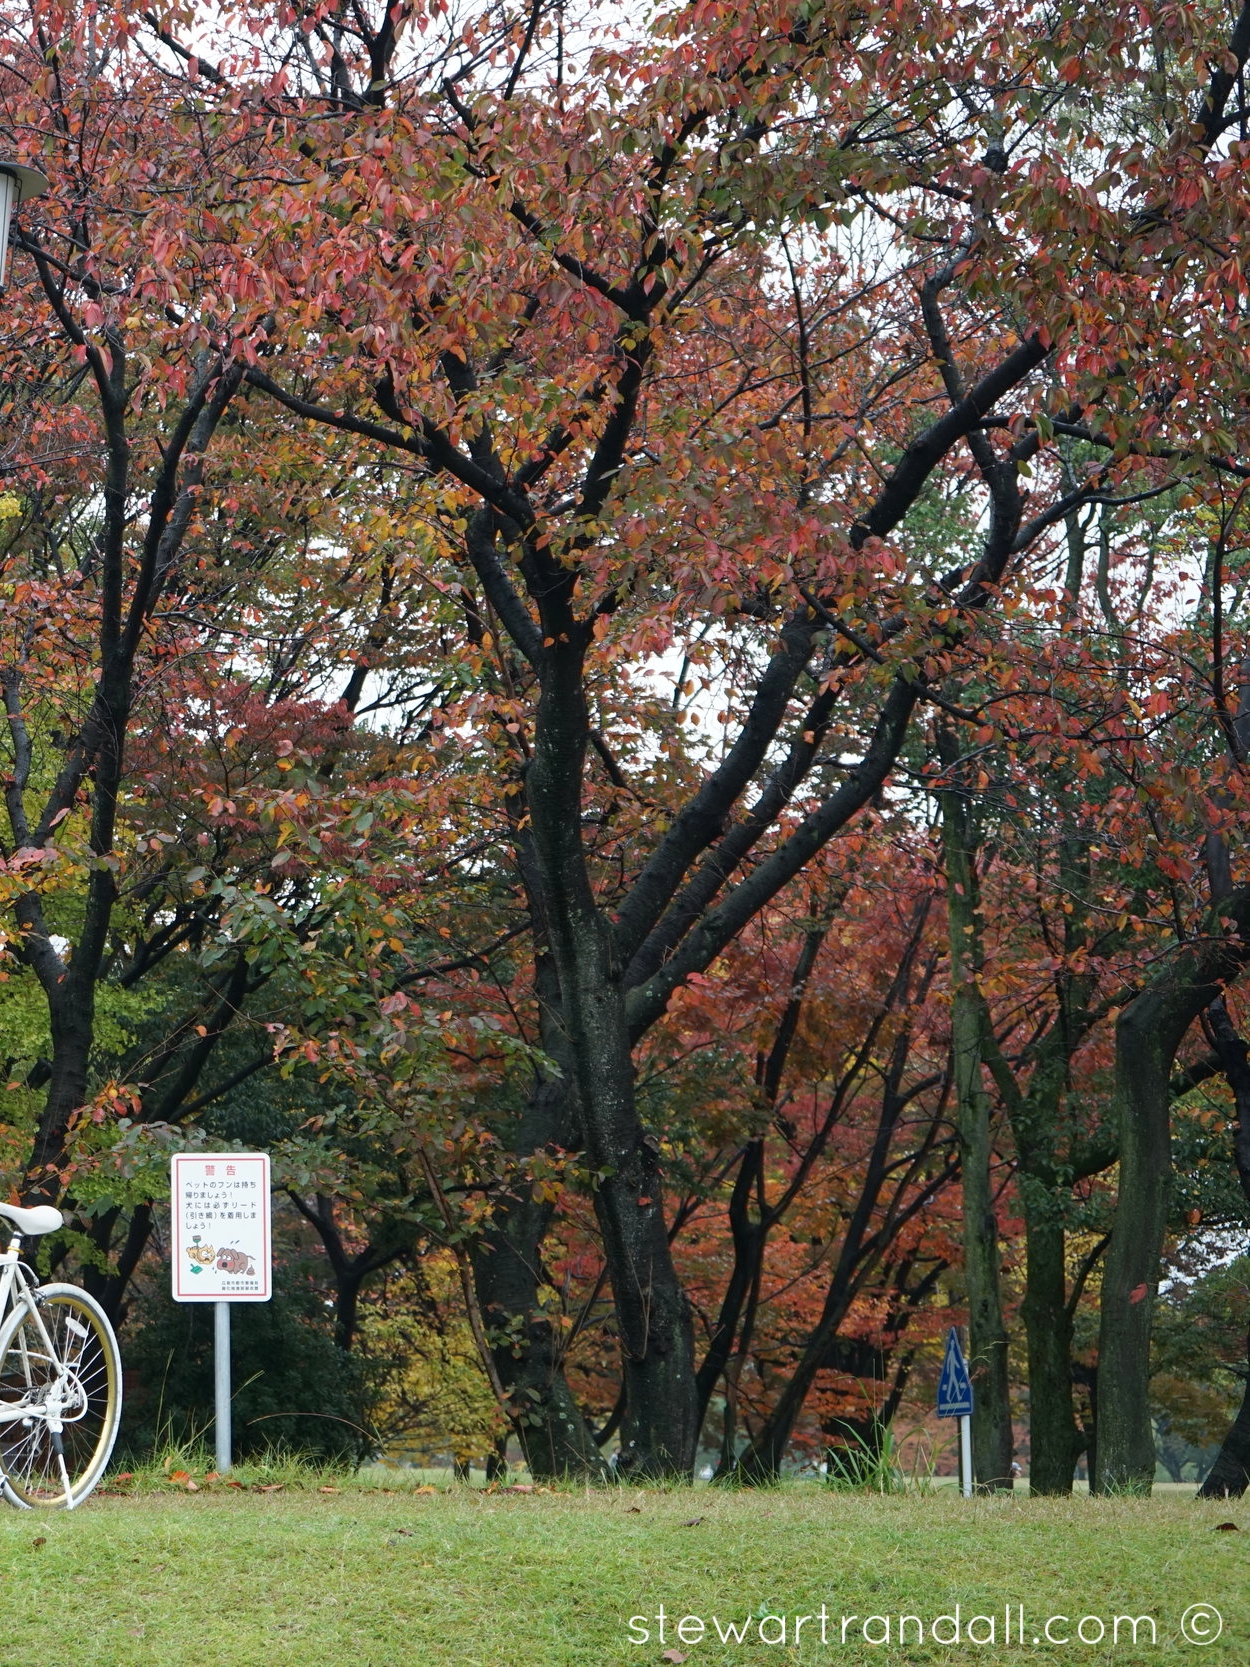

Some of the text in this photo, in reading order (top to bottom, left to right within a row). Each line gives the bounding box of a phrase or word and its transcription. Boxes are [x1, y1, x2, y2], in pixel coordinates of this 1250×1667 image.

[185, 1181, 257, 1189] ペットのフンは持ち
